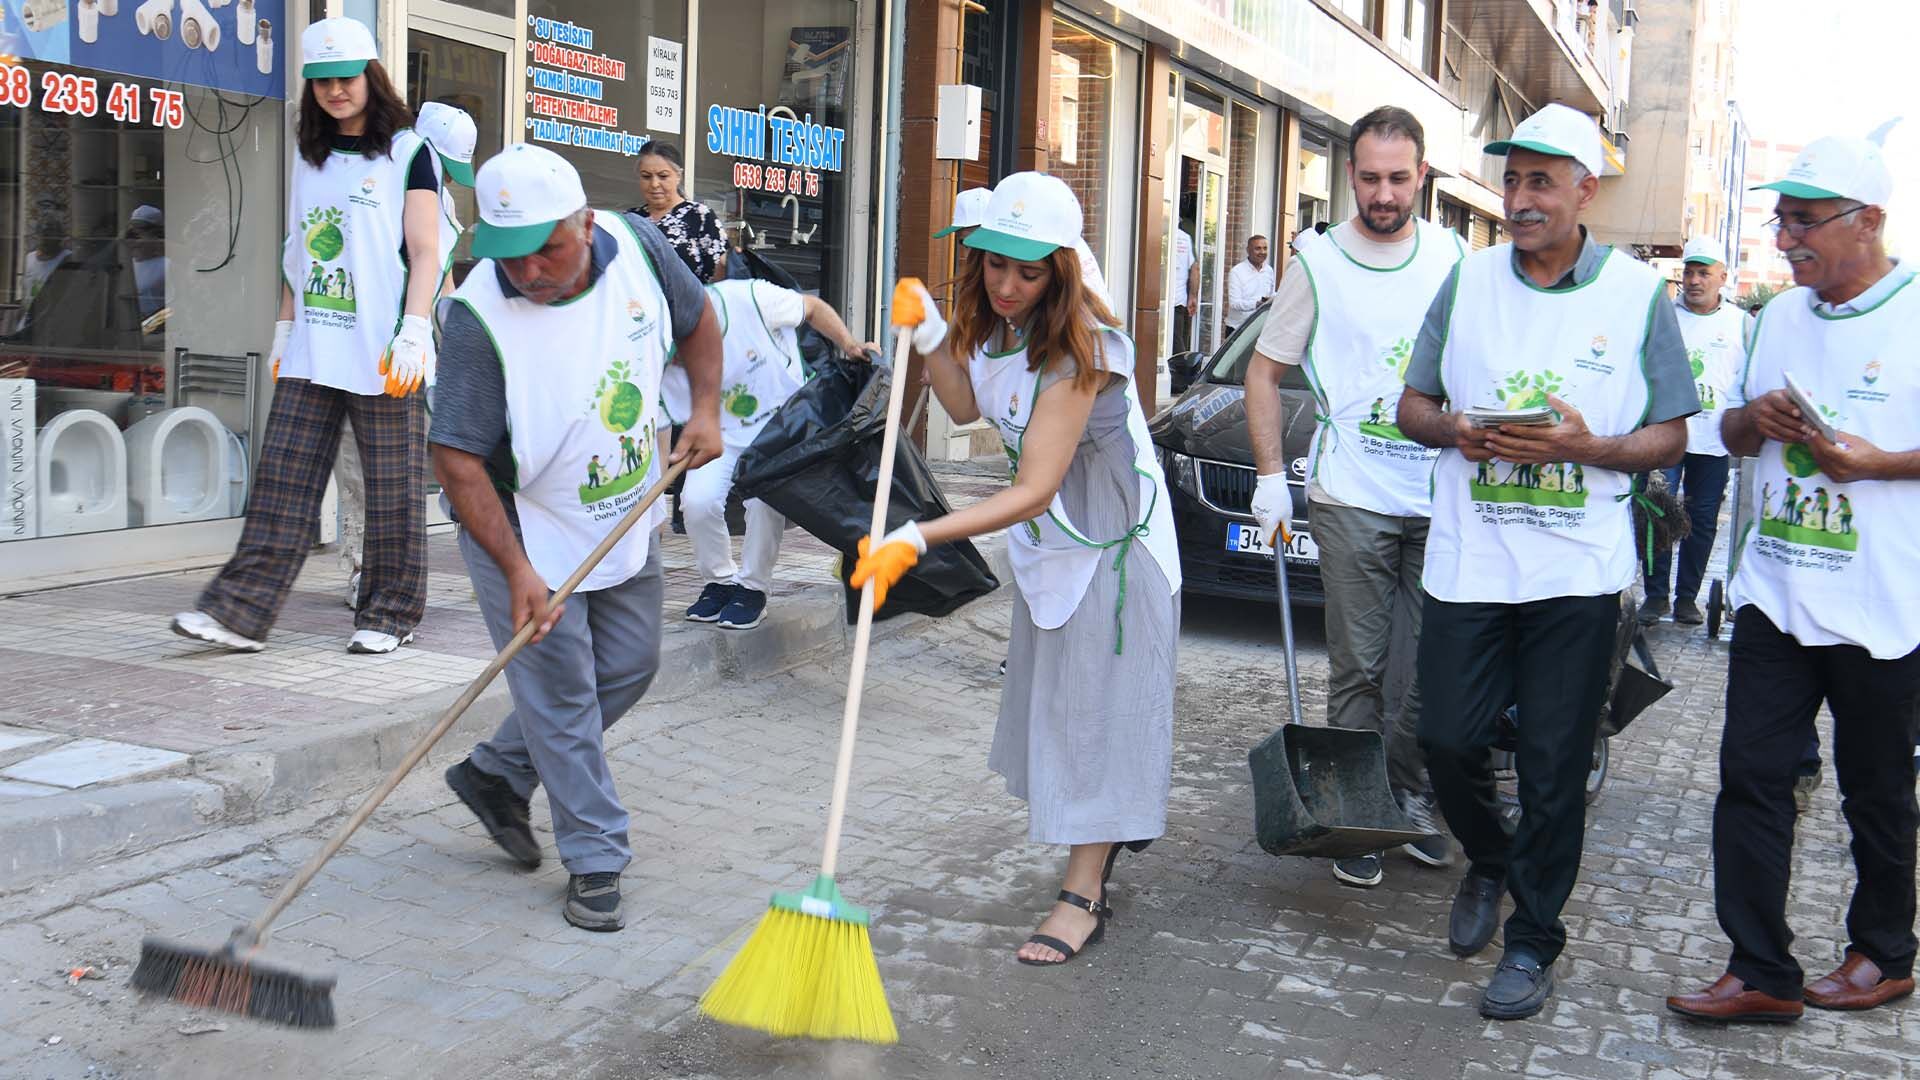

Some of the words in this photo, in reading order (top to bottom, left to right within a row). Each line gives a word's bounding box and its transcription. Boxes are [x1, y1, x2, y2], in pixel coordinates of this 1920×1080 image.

[535, 16, 550, 39] SU
[551, 21, 593, 50] TESİSATI
[534, 41, 586, 71] DOĞALGAZ
[586, 54, 626, 80] TESİSATI
[655, 66, 675, 80] DAİRE
[534, 67, 567, 93] KOMBİ
[568, 74, 602, 100] BAKIMI
[42, 72, 98, 117] 235
[106, 83, 140, 123] 41
[150, 88, 184, 128] 75
[533, 92, 565, 117] PETEK
[565, 99, 617, 127] TEMİZLEME
[533, 118, 573, 145] TADİLAT
[573, 126, 581, 147] &
[582, 127, 622, 152] TAMİRAT
[707, 104, 765, 160] SIHHİ
[769, 113, 844, 171] TESİSAT
[734, 162, 762, 190] 0538
[765, 167, 786, 192] 235
[788, 170, 801, 194] 41
[805, 173, 818, 197] 75
[1364, 446, 1384, 456] Daha
[1371, 438, 1383, 448] Bo
[594, 511, 617, 521] Daha
[598, 501, 612, 511] Bo
[1475, 503, 1484, 513] Ji
[1240, 529, 1262, 551] 34
[1296, 558, 1320, 566] AUTO
